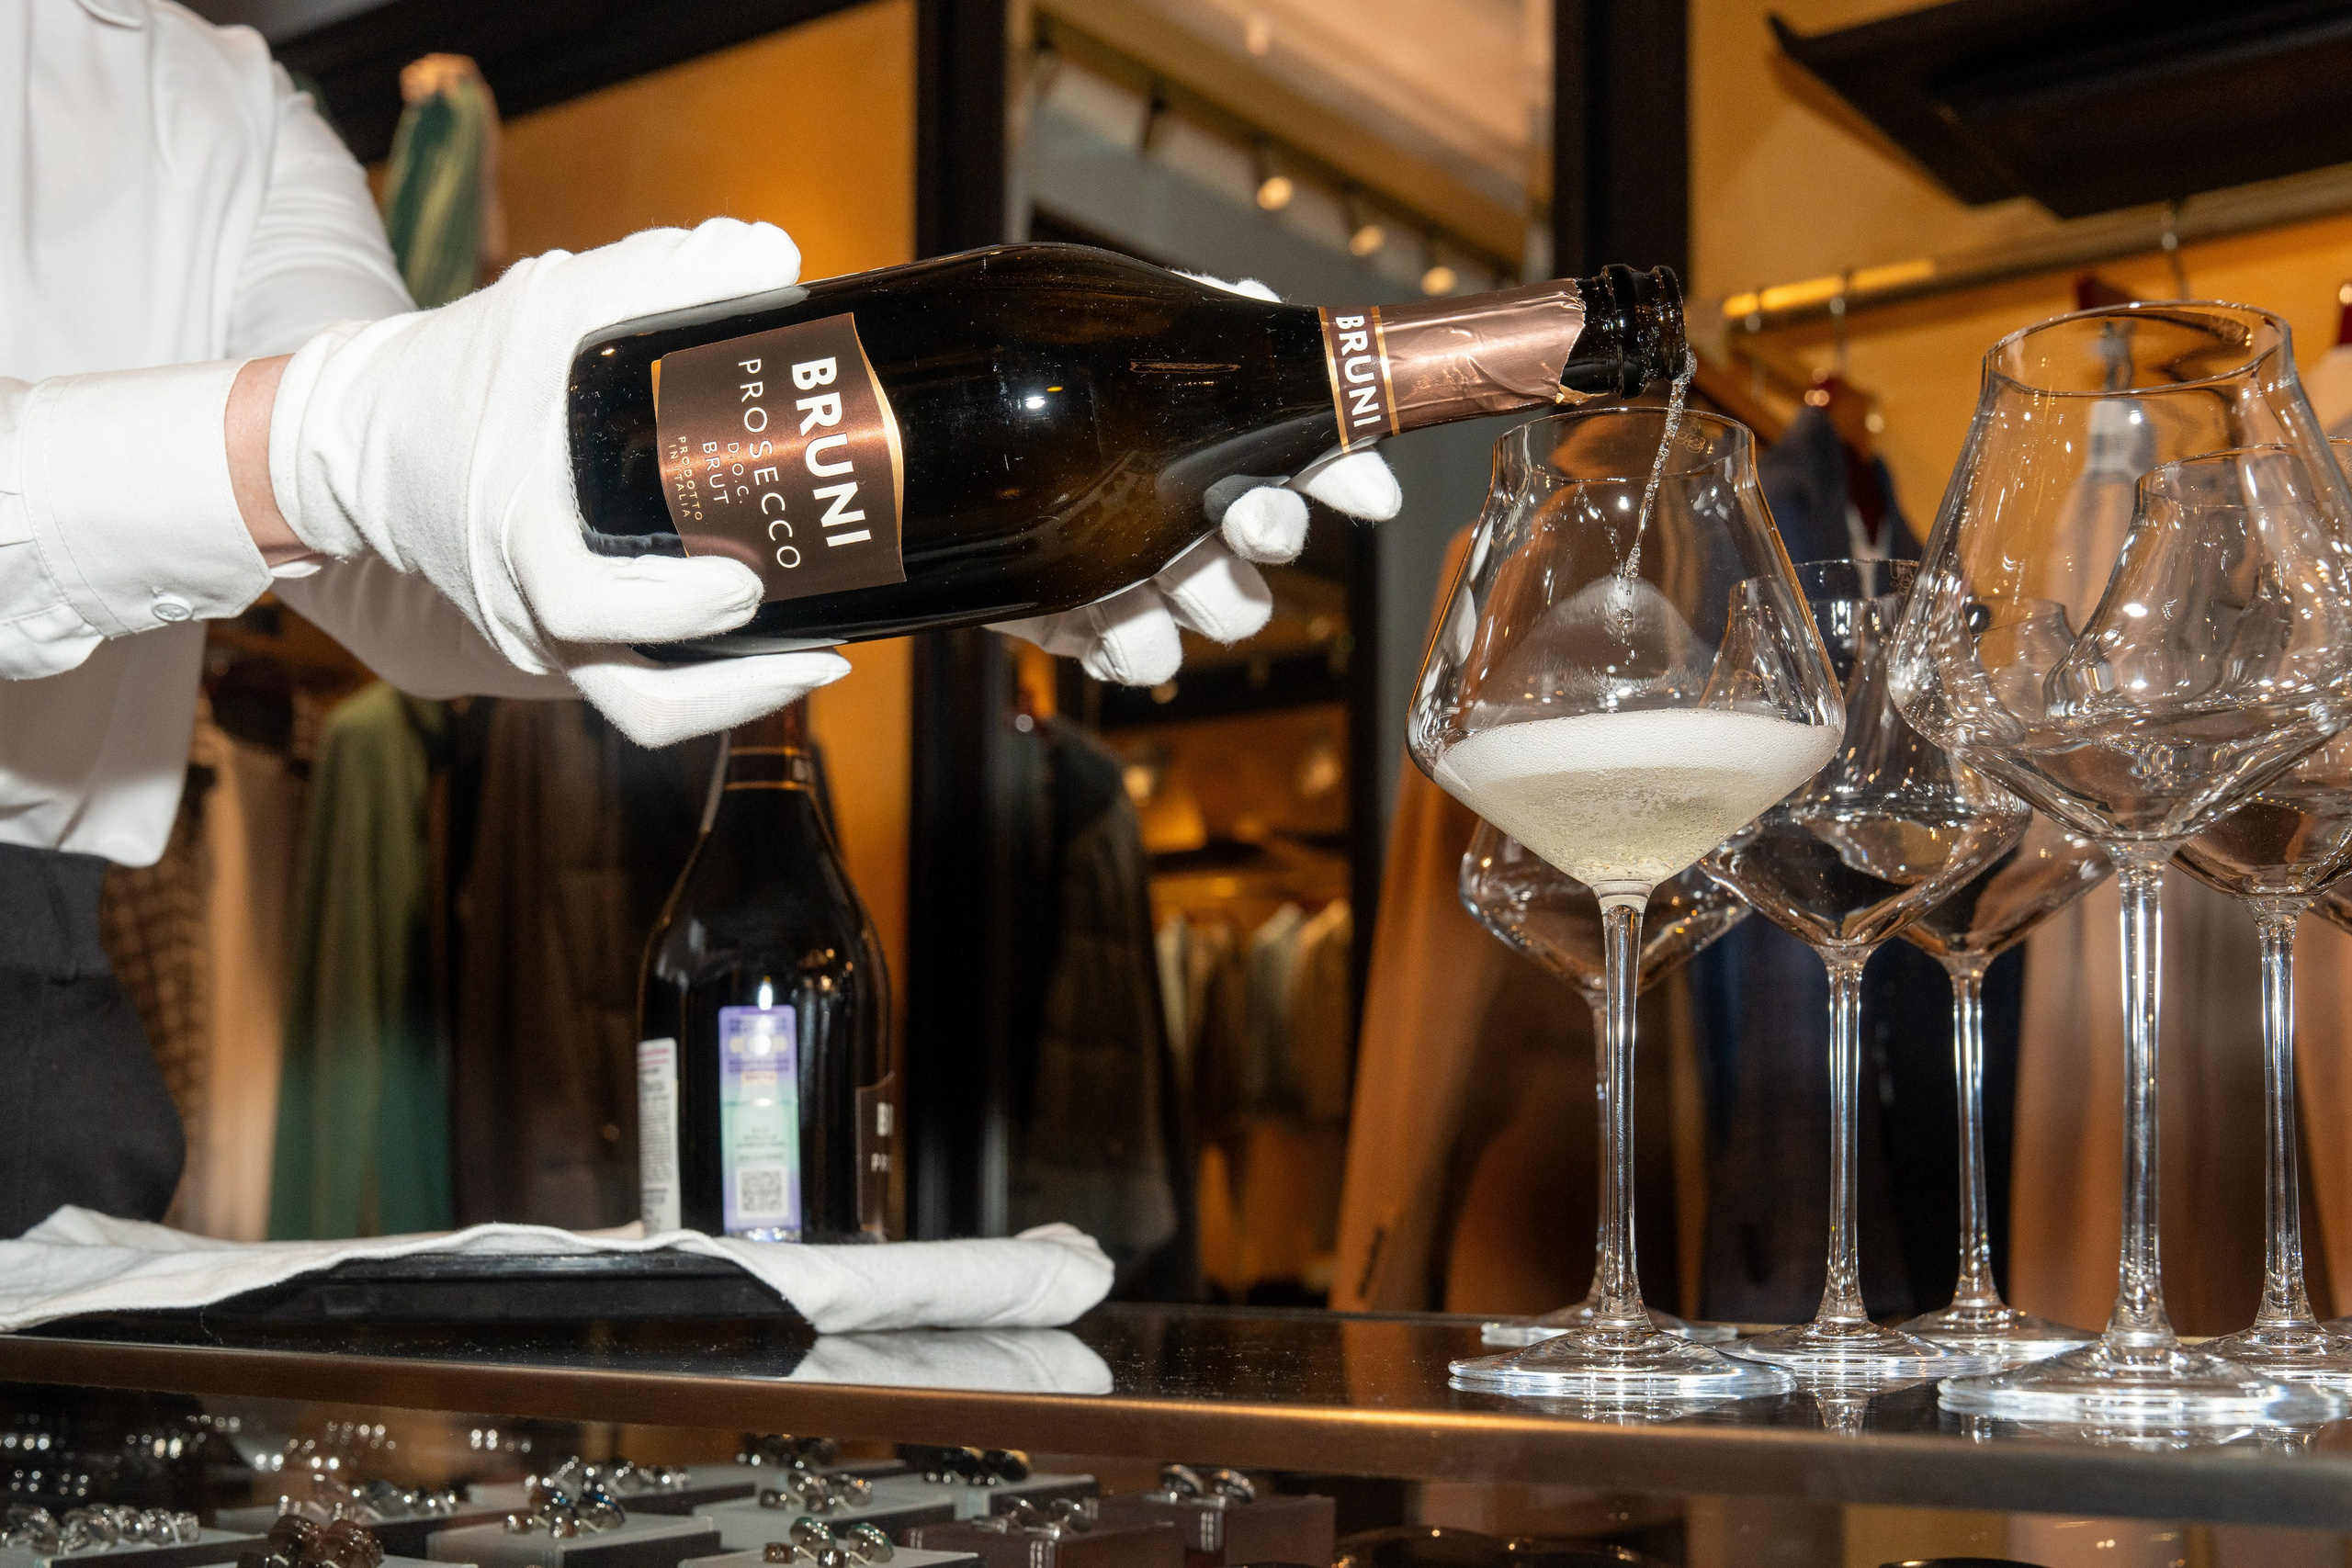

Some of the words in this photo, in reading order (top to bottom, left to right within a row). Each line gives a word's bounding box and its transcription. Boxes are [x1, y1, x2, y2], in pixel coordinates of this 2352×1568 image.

[1335, 315, 1381, 427] BRUNI
[668, 444, 679, 459] IN
[678, 435, 703, 521] PRODOTTO
[702, 441, 729, 504] BRUT
[727, 442, 750, 504] D.O.C.
[738, 358, 801, 569] PROSECCO
[792, 356, 872, 547] BRUNI
[673, 467, 691, 517] ITALIA
